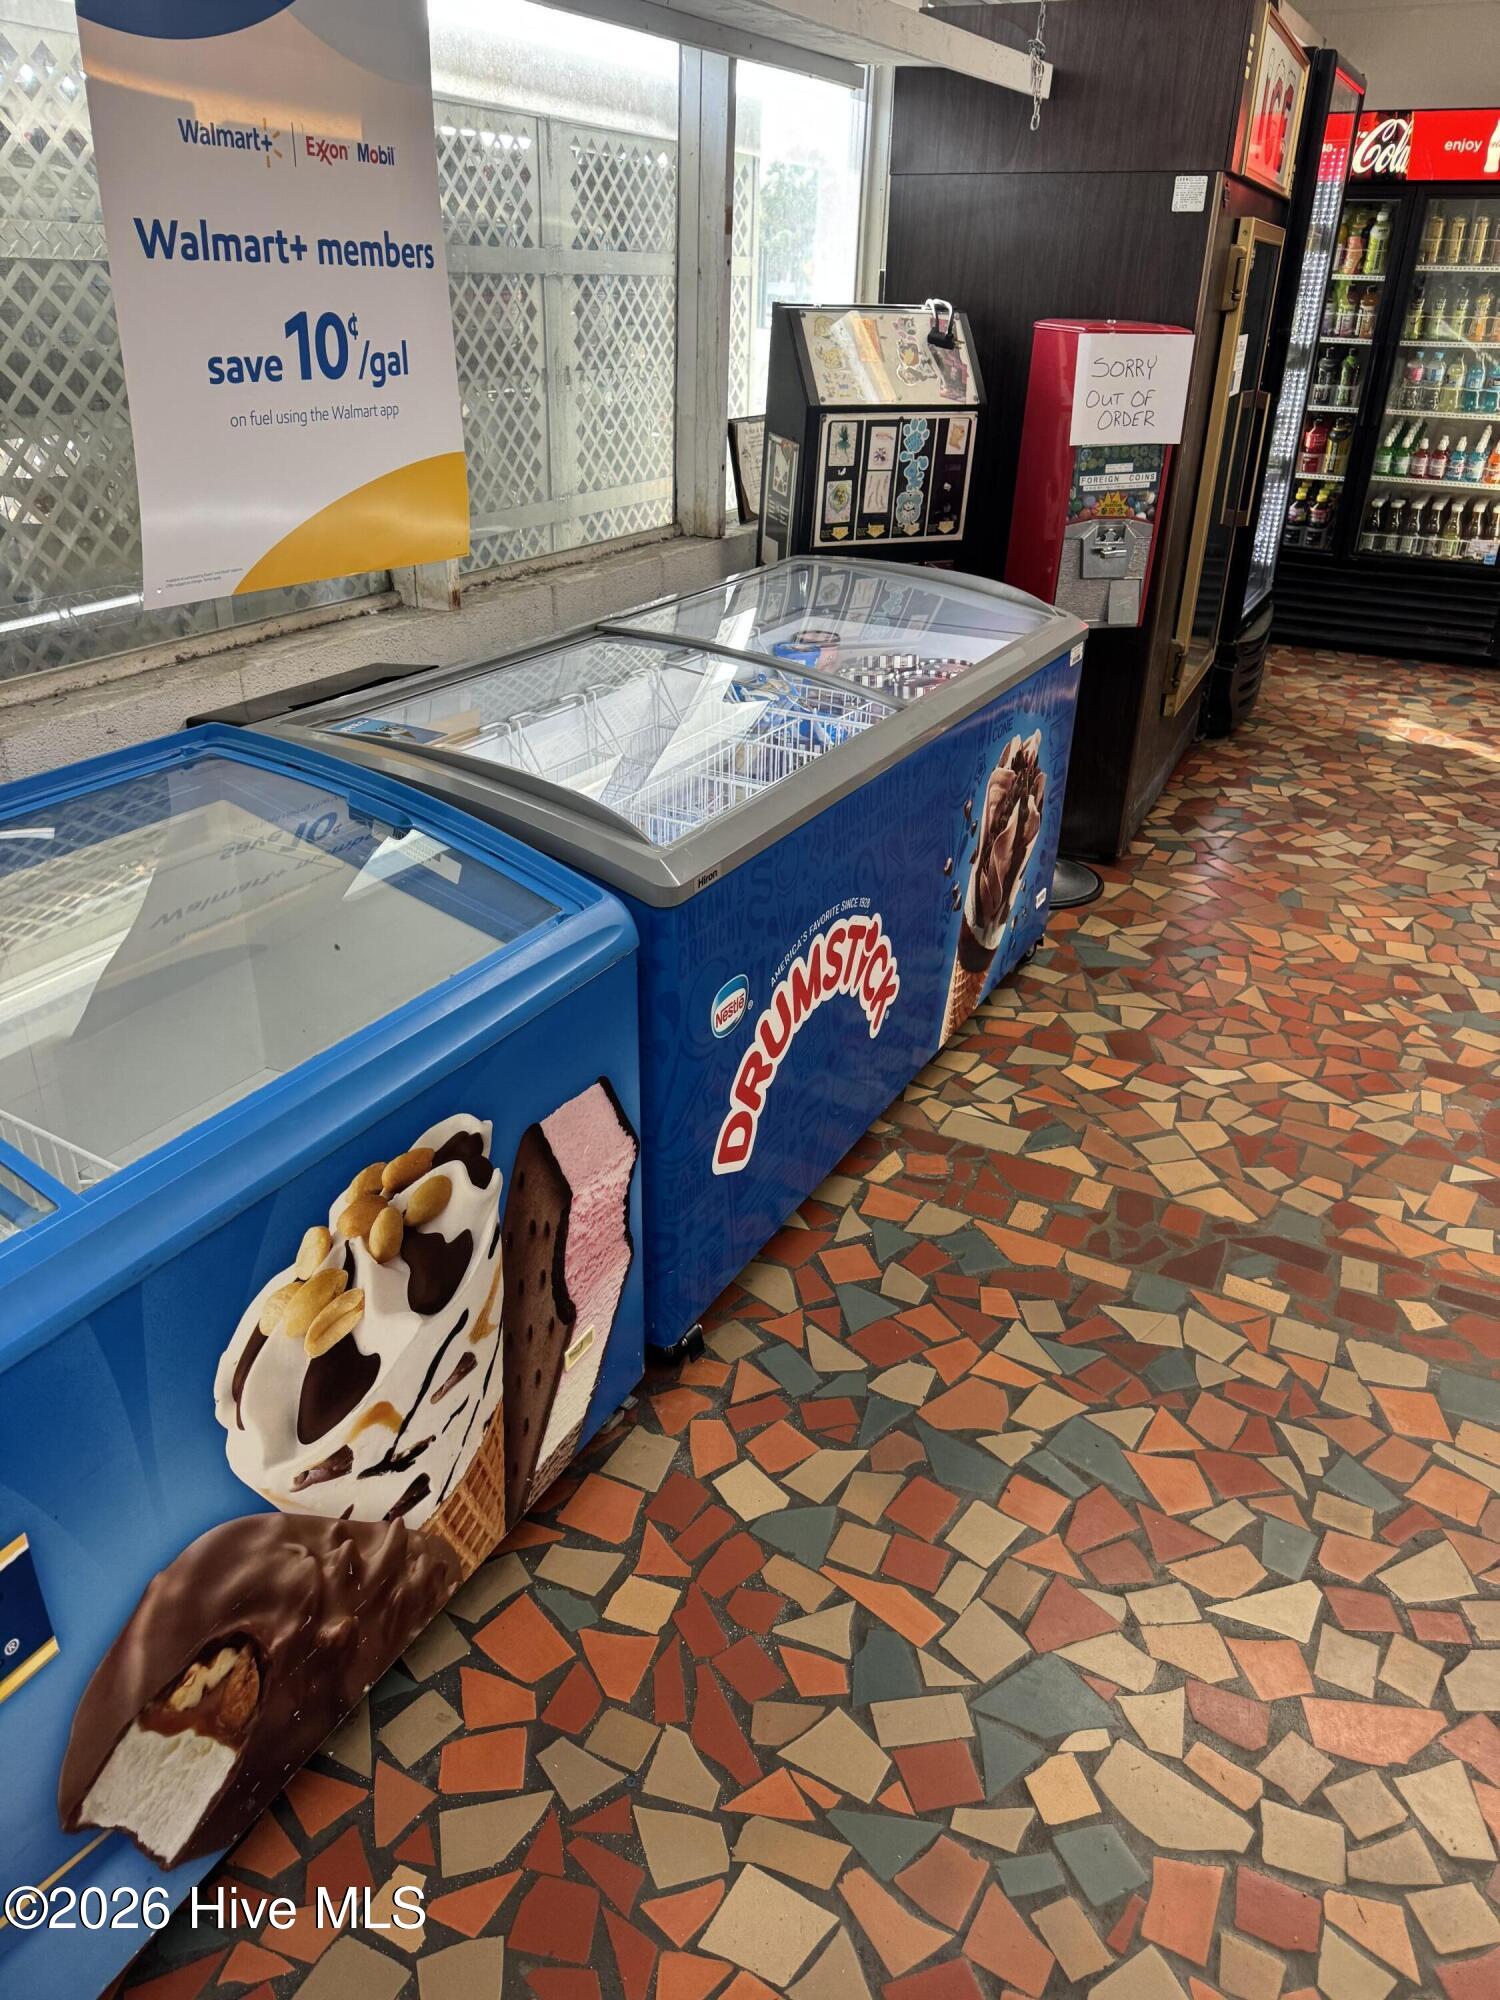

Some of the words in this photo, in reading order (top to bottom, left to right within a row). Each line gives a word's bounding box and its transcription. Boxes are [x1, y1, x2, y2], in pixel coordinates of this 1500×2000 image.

[178, 118, 273, 152] Walmart+
[305, 136, 349, 166] Exxon
[356, 142, 395, 166] Mobil
[1444, 137, 1483, 153] enjoy
[133, 217, 308, 265] Walmart+
[317, 230, 435, 270] members
[207, 354, 284, 385] save
[1090, 354, 1158, 381] SORRY
[1085, 389, 1125, 409] OUT
[1131, 389, 1156, 408] OF
[230, 413, 247, 428] on
[250, 409, 273, 426] fuel
[276, 409, 308, 427] using
[310, 406, 330, 422] the
[331, 404, 378, 420] Walmart
[380, 404, 400, 420] app
[1097, 410, 1155, 431] ORDER
[1080, 475, 1120, 485] FOREIGN
[1128, 473, 1155, 482] COINS
[697, 868, 718, 889] Hiron
[771, 931, 808, 988] AMERICA'S
[809, 903, 840, 936] FAVORITE
[840, 897, 859, 912] SINCE
[715, 993, 745, 1029] Nestlé
[716, 920, 898, 1166] DRUMSTICK
